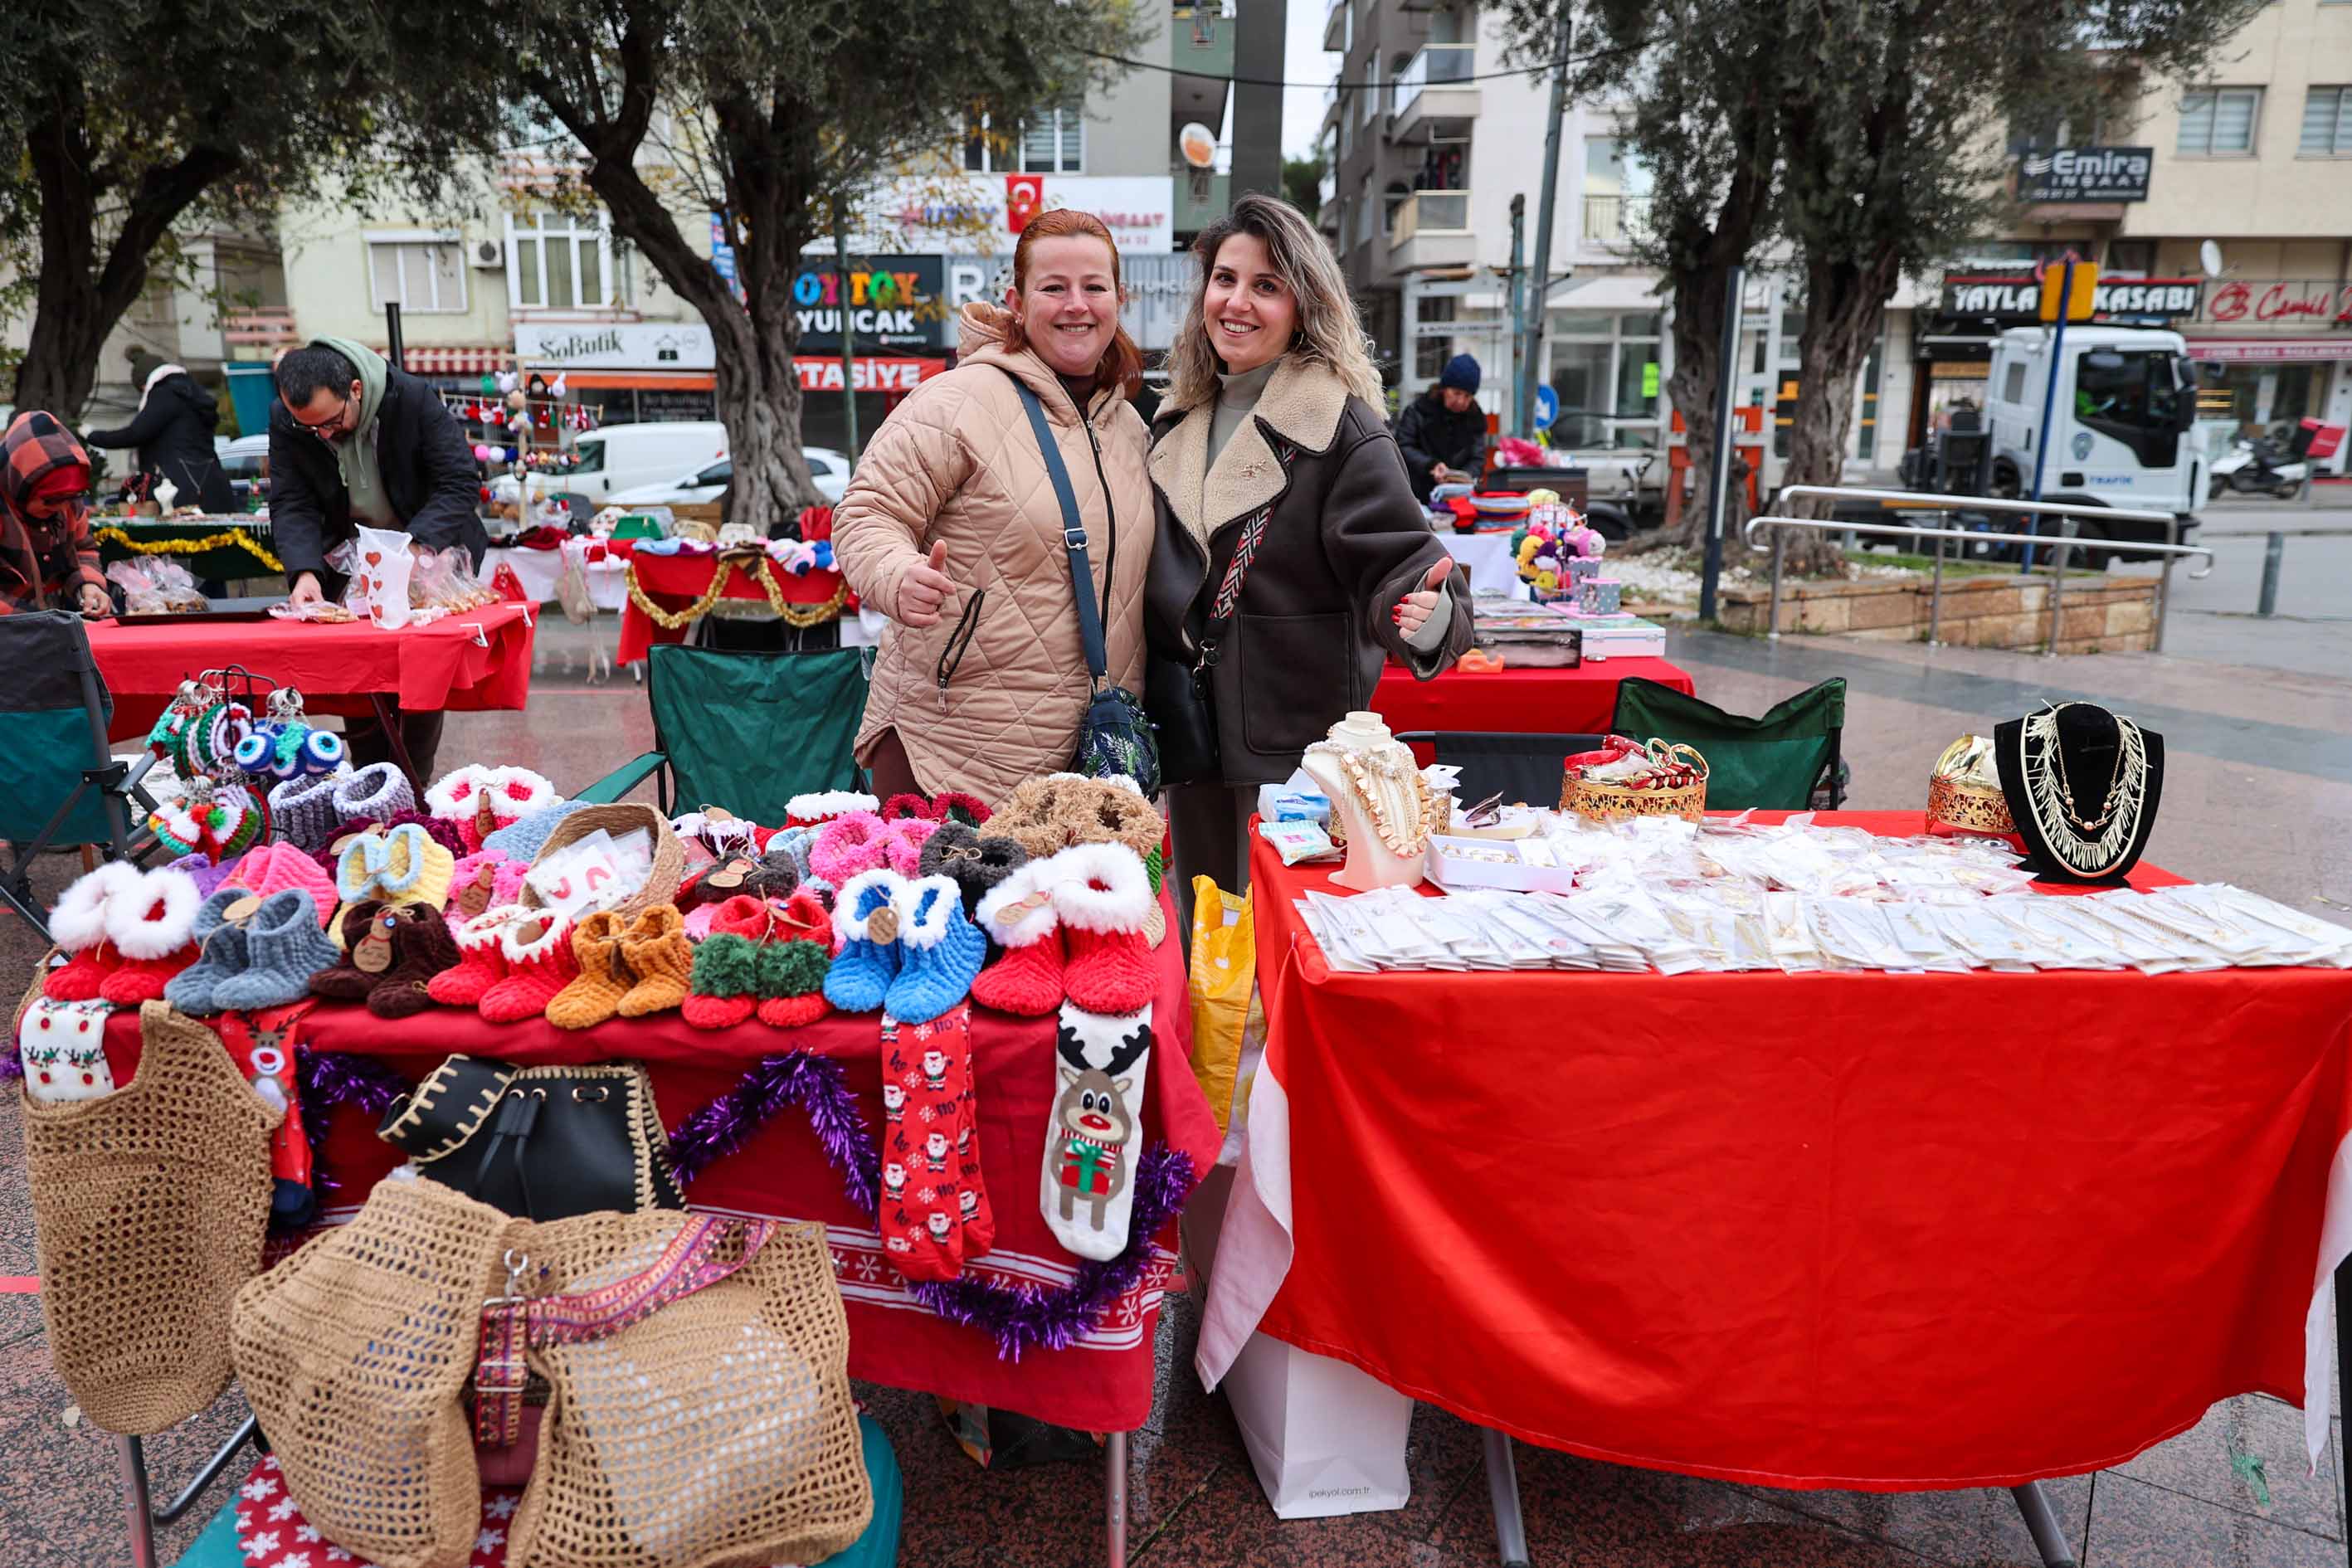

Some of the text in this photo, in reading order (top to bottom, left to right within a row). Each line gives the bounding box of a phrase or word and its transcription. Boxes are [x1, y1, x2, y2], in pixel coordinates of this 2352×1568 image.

[2053, 150, 2149, 176] Emira
[794, 271, 839, 306] OY
[1955, 285, 2038, 312] YAYLA
[796, 309, 915, 334] YUNCAK
[793, 358, 921, 389] TASİYE
